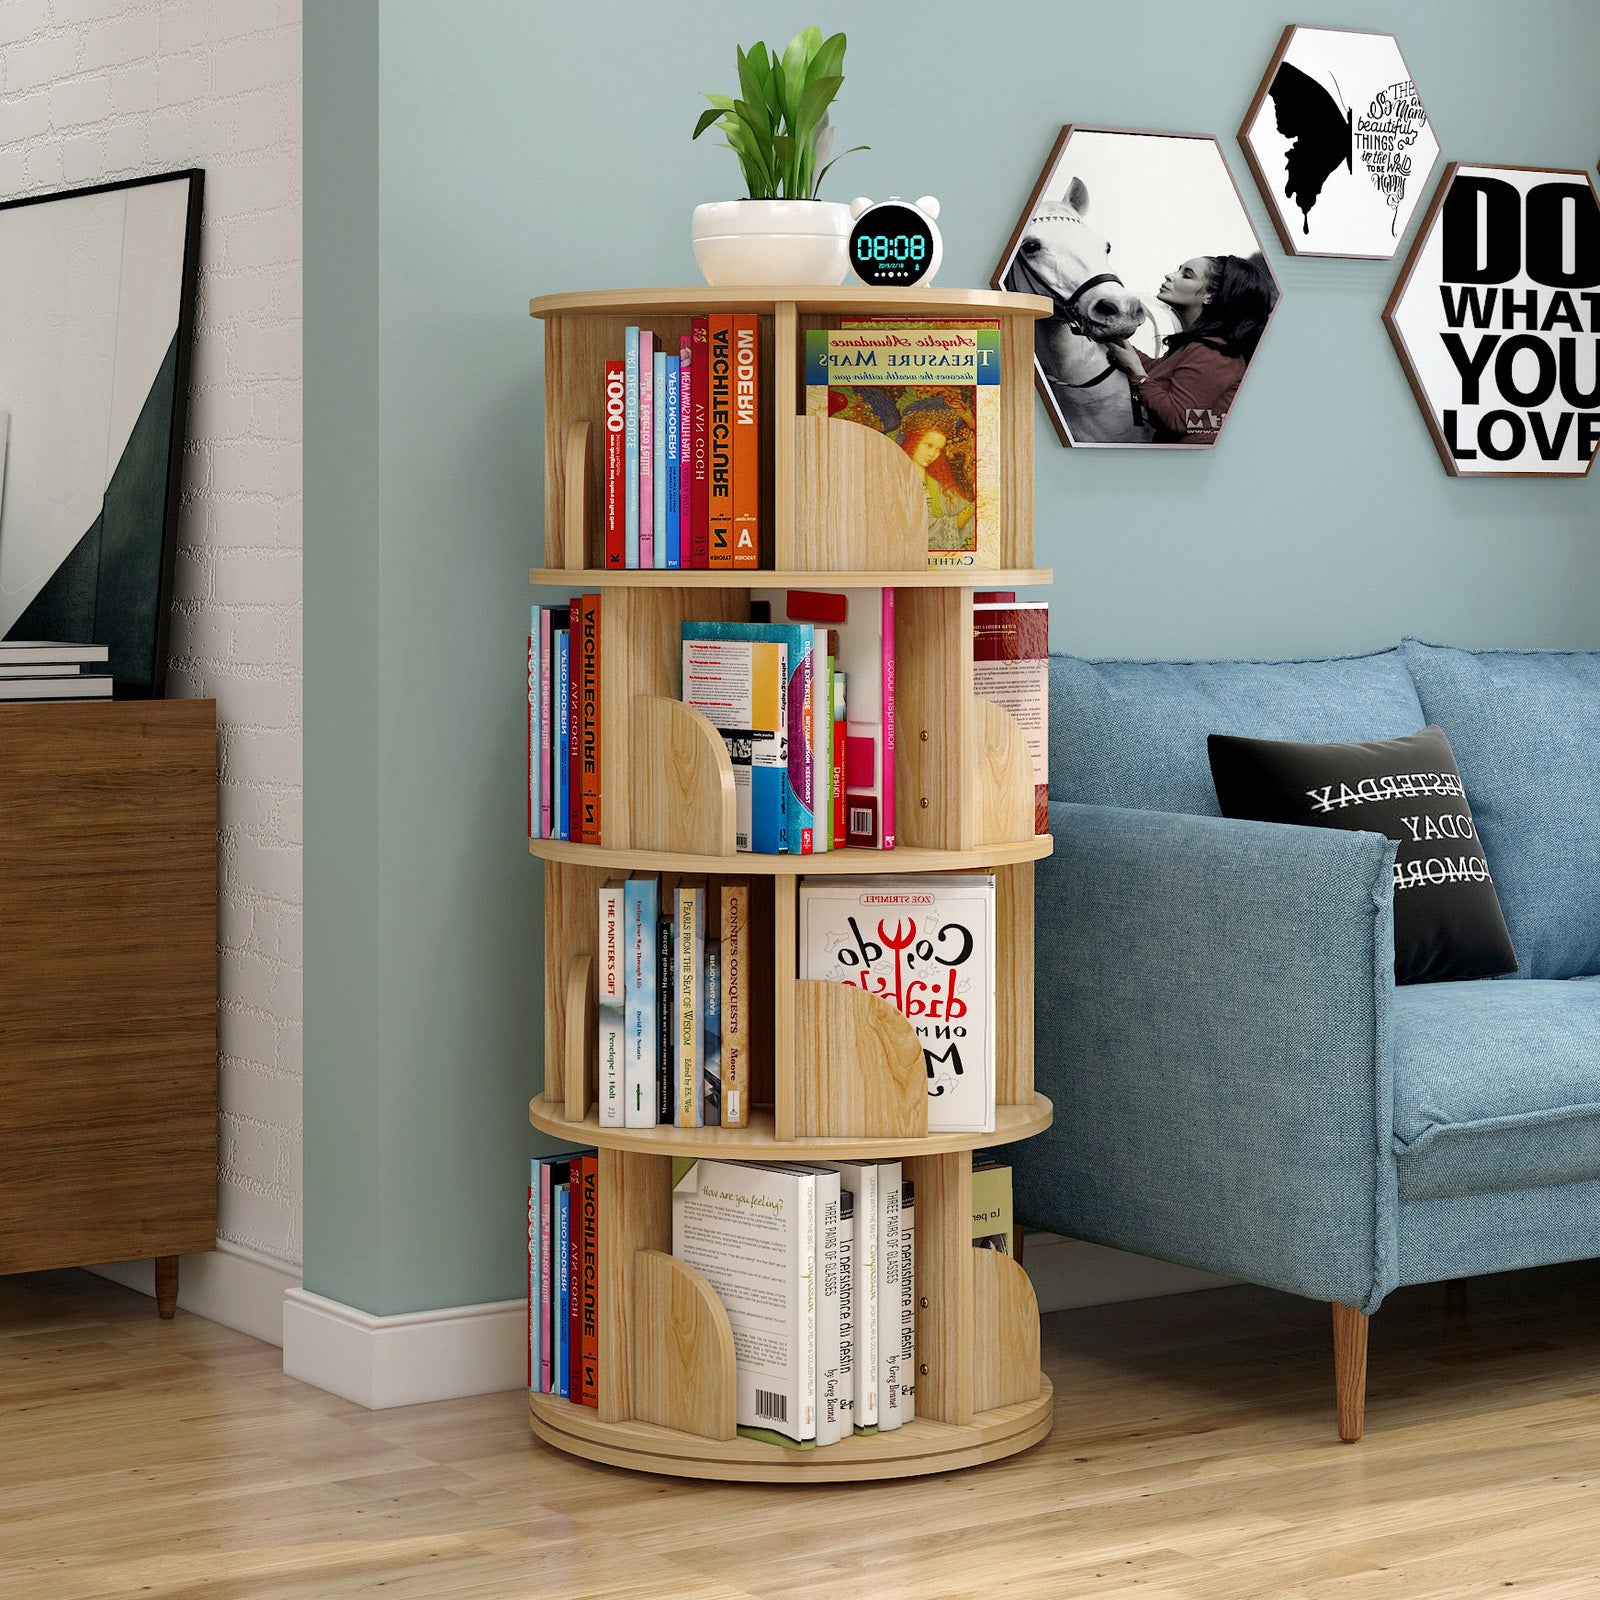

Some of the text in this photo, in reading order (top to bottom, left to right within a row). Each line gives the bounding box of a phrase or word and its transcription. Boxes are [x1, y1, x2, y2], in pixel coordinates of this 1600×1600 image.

[1354, 133, 1394, 151] THINGS
[1358, 116, 1414, 139] beautiful
[858, 235, 925, 260] 08:08
[1443, 175, 1600, 289] DO
[1439, 285, 1600, 333] WHAT
[1440, 333, 1600, 409] YOU
[1443, 409, 1600, 461] LOVE
[780, 662, 788, 711] photography
[886, 696, 894, 750] inspiration
[607, 973, 615, 996] GIFT
[683, 901, 693, 1045] PEARLS FROM THE SEAT OF WISDOM
[729, 898, 739, 1081] CONNIE'S CONQUESTS Moore
[606, 1032, 615, 1071] Penelope
[684, 1058, 692, 1078] Edited
[608, 1081, 616, 1099] Holt
[684, 1099, 692, 1113] Wise
[702, 1185, 719, 1197] How
[720, 1192, 732, 1200] are
[735, 1193, 749, 1207] you
[750, 1194, 783, 1216] feeling?
[824, 1201, 836, 1297] THREE PAIRS OF GLASSES
[886, 1190, 898, 1284] THREE PAIRS OF GLASSES
[824, 1369, 838, 1423] by Greg Bennet
[886, 1355, 899, 1409] by Greg Bennet
